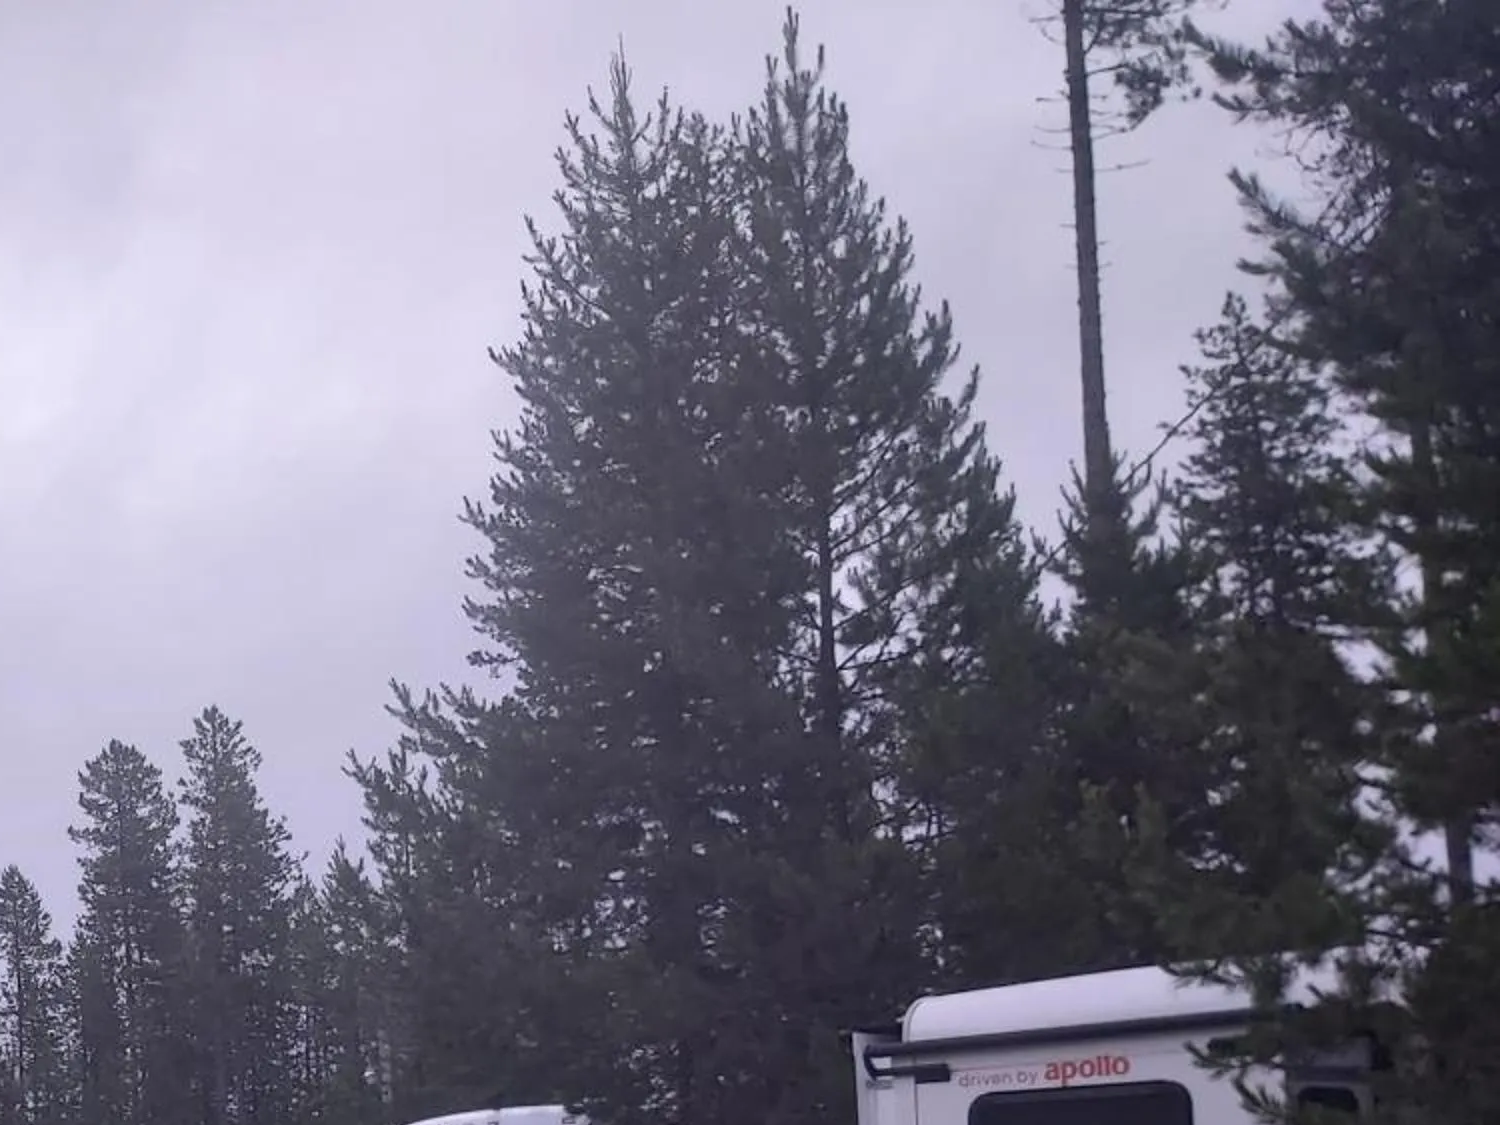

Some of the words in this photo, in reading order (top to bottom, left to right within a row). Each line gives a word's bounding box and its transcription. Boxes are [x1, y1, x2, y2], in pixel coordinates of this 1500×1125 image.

[958, 1070, 1012, 1088] driven
[1017, 1069, 1039, 1086] by
[1043, 1055, 1131, 1087] apollo
